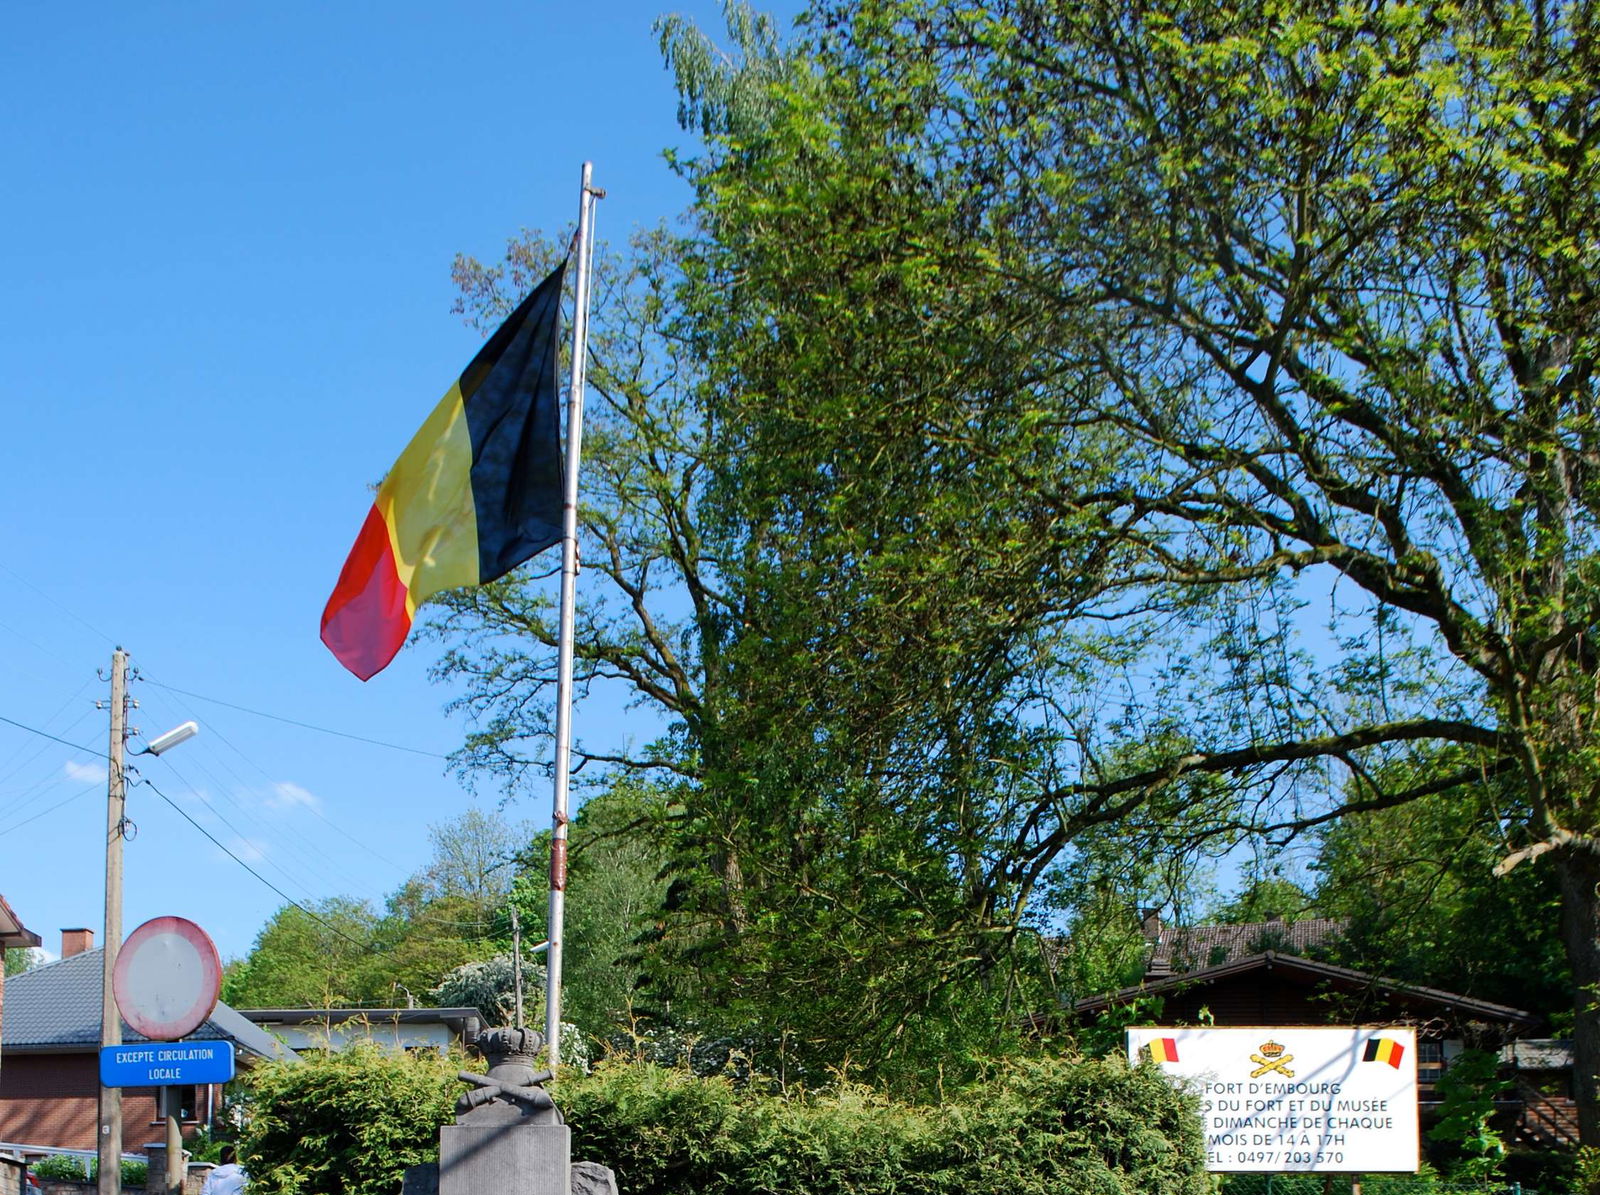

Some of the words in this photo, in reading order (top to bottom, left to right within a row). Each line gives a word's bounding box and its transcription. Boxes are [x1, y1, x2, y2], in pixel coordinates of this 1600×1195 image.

[116, 1051, 154, 1064] EXCEPTE
[158, 1049, 213, 1062] CIRCULATION
[148, 1068, 181, 1080] LOCALE
[1205, 1083, 1243, 1095] FORT
[1249, 1082, 1342, 1095] D'EMBOURG
[1218, 1100, 1239, 1112] DU
[1246, 1100, 1283, 1112] FORT
[1289, 1100, 1304, 1112] ET
[1311, 1100, 1332, 1112] DU
[1337, 1096, 1388, 1112] MUSÉE
[1214, 1117, 1297, 1129] DIMANCHE
[1303, 1117, 1322, 1129] DE
[1327, 1117, 1393, 1130] CHAQUE
[1208, 1134, 1247, 1146] MOIS
[1253, 1134, 1272, 1146] DE
[1278, 1134, 1295, 1146] 14
[1317, 1134, 1345, 1146] 17H
[1316, 1152, 1343, 1164] 570
